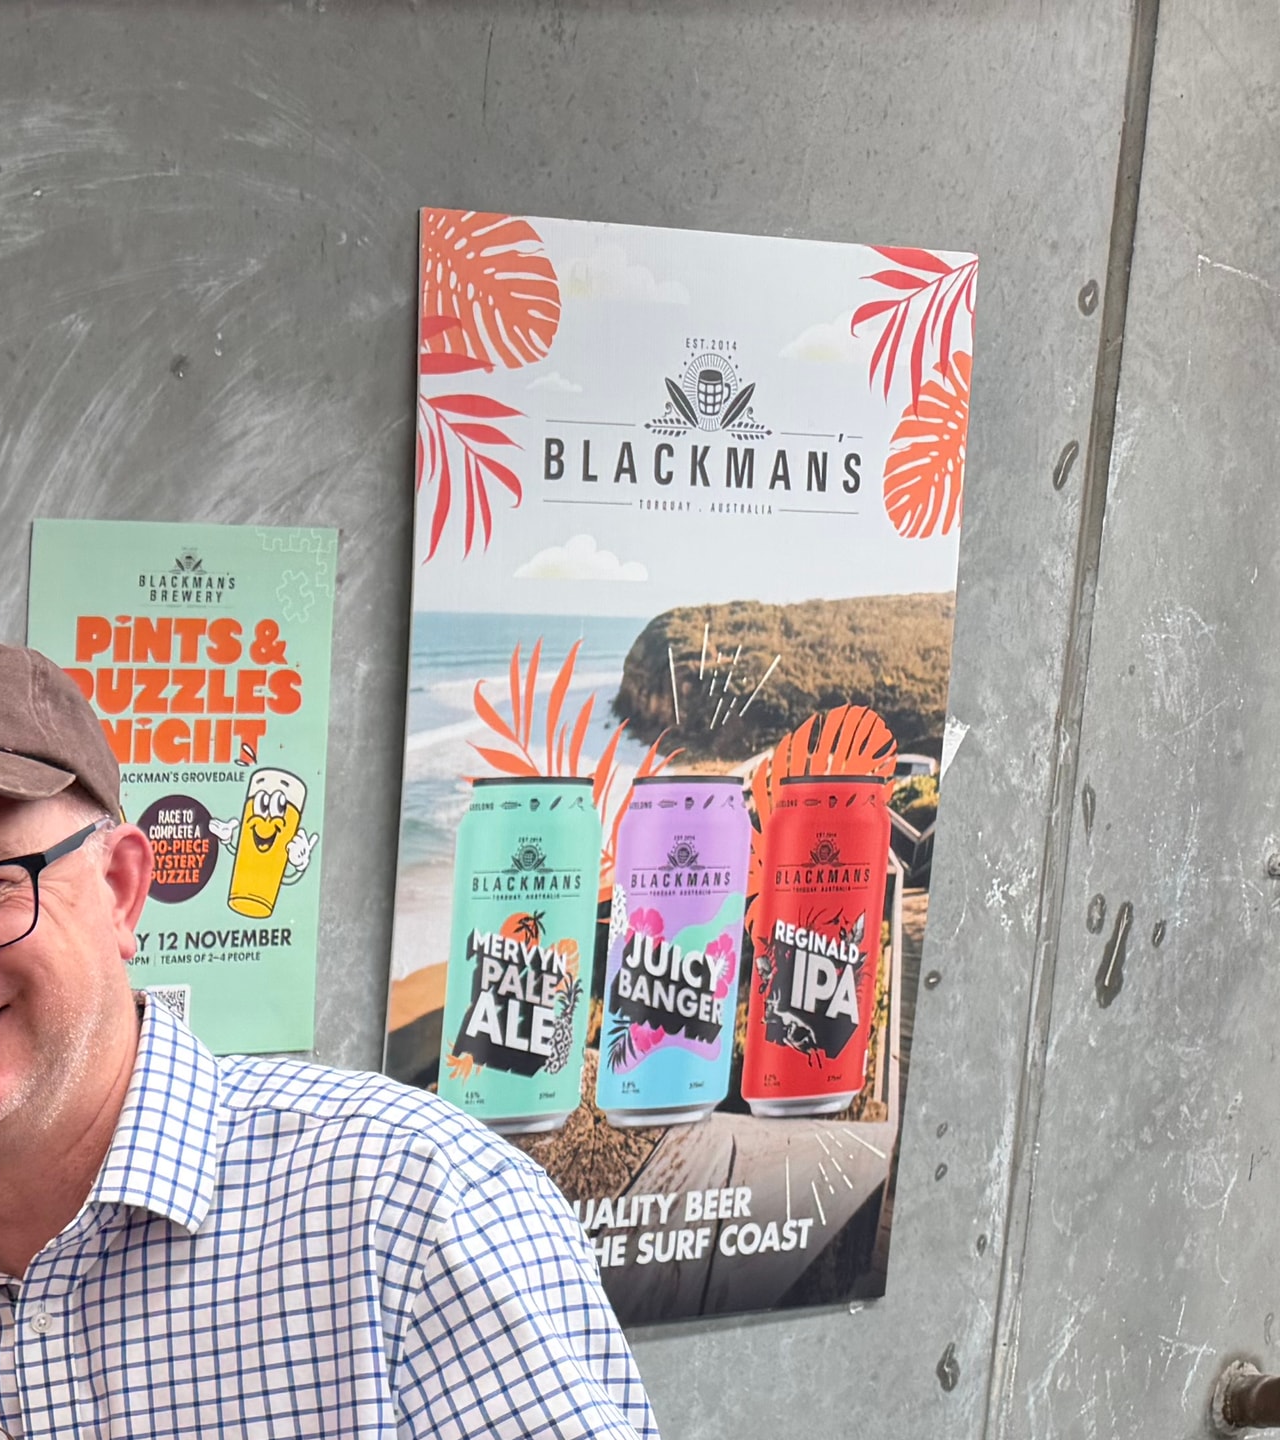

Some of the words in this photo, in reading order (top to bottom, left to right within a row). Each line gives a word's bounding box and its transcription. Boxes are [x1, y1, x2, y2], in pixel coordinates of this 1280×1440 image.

[685, 337, 738, 351] EST.2014
[639, 499, 692, 512] TORQUAY
[710, 503, 774, 515] AUSTRALIA
[150, 589, 223, 603] BREWERY
[248, 618, 288, 665] &
[120, 771, 180, 784] ACKMAN'S
[181, 771, 245, 784] GROVEDALE
[149, 825, 193, 840] COMPLETE
[194, 825, 201, 839] A
[158, 809, 181, 824] RACE
[182, 809, 193, 823] TO
[151, 869, 200, 885] PUZZLE
[154, 854, 205, 870] YSTERY
[158, 932, 178, 950] 12
[185, 928, 292, 950] NOVEMBER
[472, 928, 568, 976] MERVYN
[775, 918, 860, 965] REGINALD
[160, 954, 191, 965] TEAMS
[194, 953, 206, 963] OF
[228, 952, 261, 962] PEOPLE
[625, 931, 726, 992] JUICY
[481, 957, 558, 1007] PALE
[618, 968, 724, 1026] BANGER
[790, 949, 860, 1025] IPA
[466, 990, 555, 1057] ALE
[573, 1191, 678, 1231] UALITY
[684, 1186, 752, 1223] BEER
[590, 1235, 627, 1268] HE
[636, 1227, 712, 1265] SURF
[719, 1217, 814, 1257] COAST
